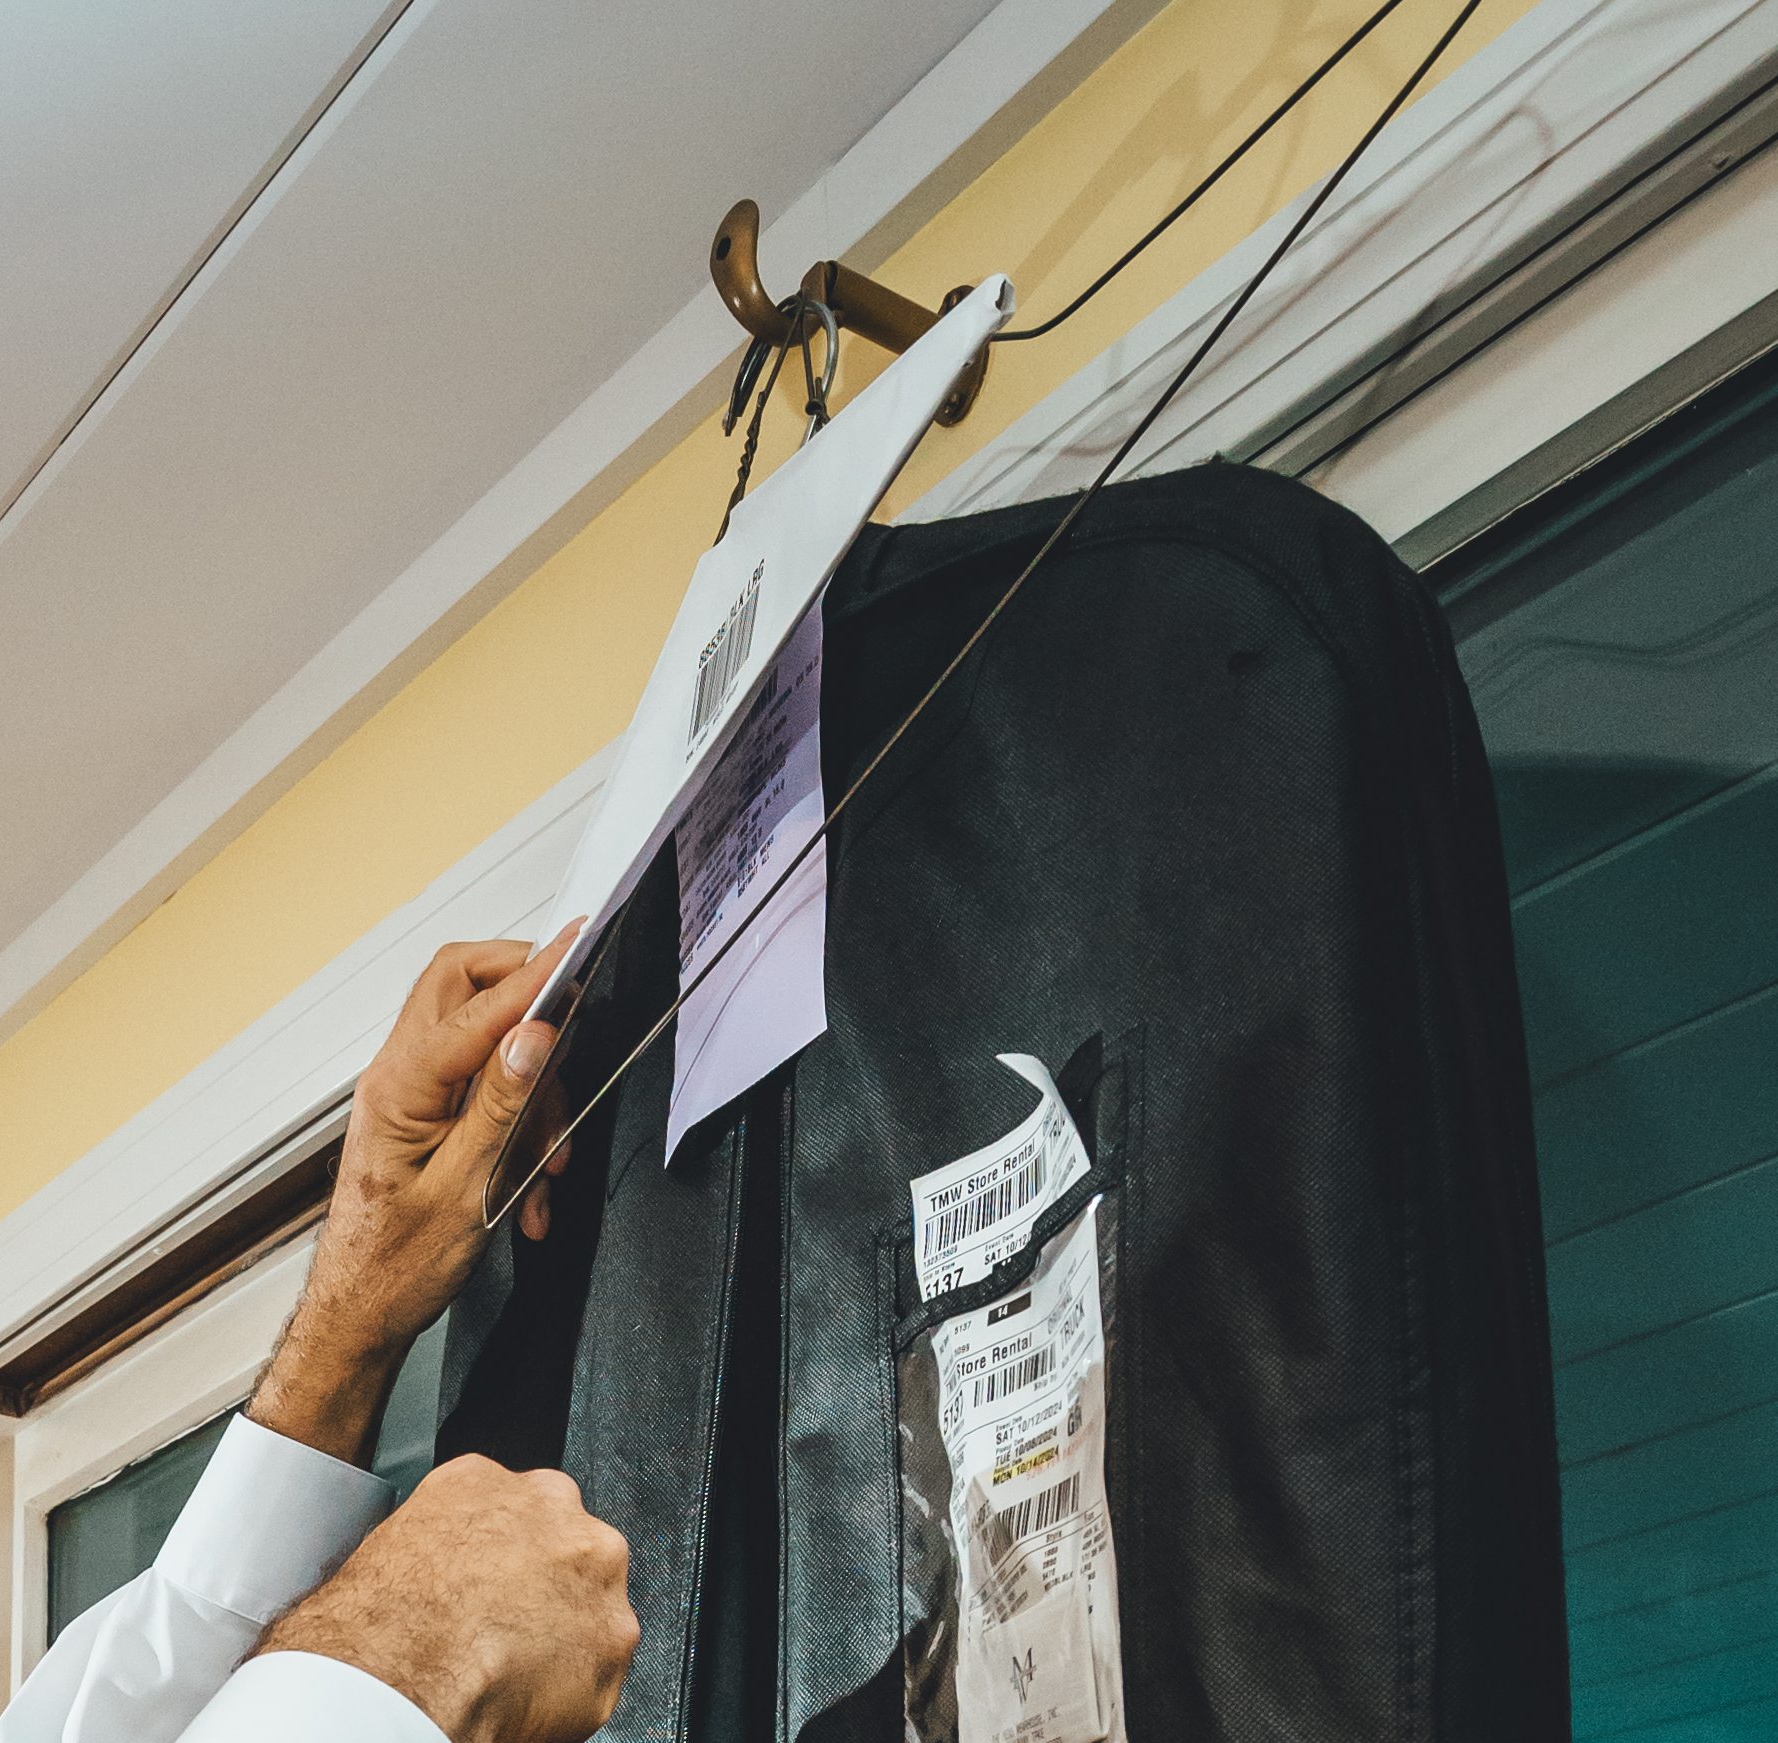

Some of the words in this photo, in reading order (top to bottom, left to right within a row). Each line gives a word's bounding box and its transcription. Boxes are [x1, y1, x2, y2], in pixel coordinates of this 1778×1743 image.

[931, 1184, 964, 1213] TMW
[967, 1170, 999, 1195] Store
[1003, 1138, 1036, 1176] Rental
[984, 1249, 1002, 1267] SAT
[991, 1331, 1033, 1362] Rental
[995, 1429, 1015, 1446] SAT
[1018, 1401, 1063, 1434] 10/12/2024
[993, 1470, 1013, 1487] MON
[1016, 1444, 1060, 1476] 10/14/2024
[995, 1450, 1012, 1467] TUE
